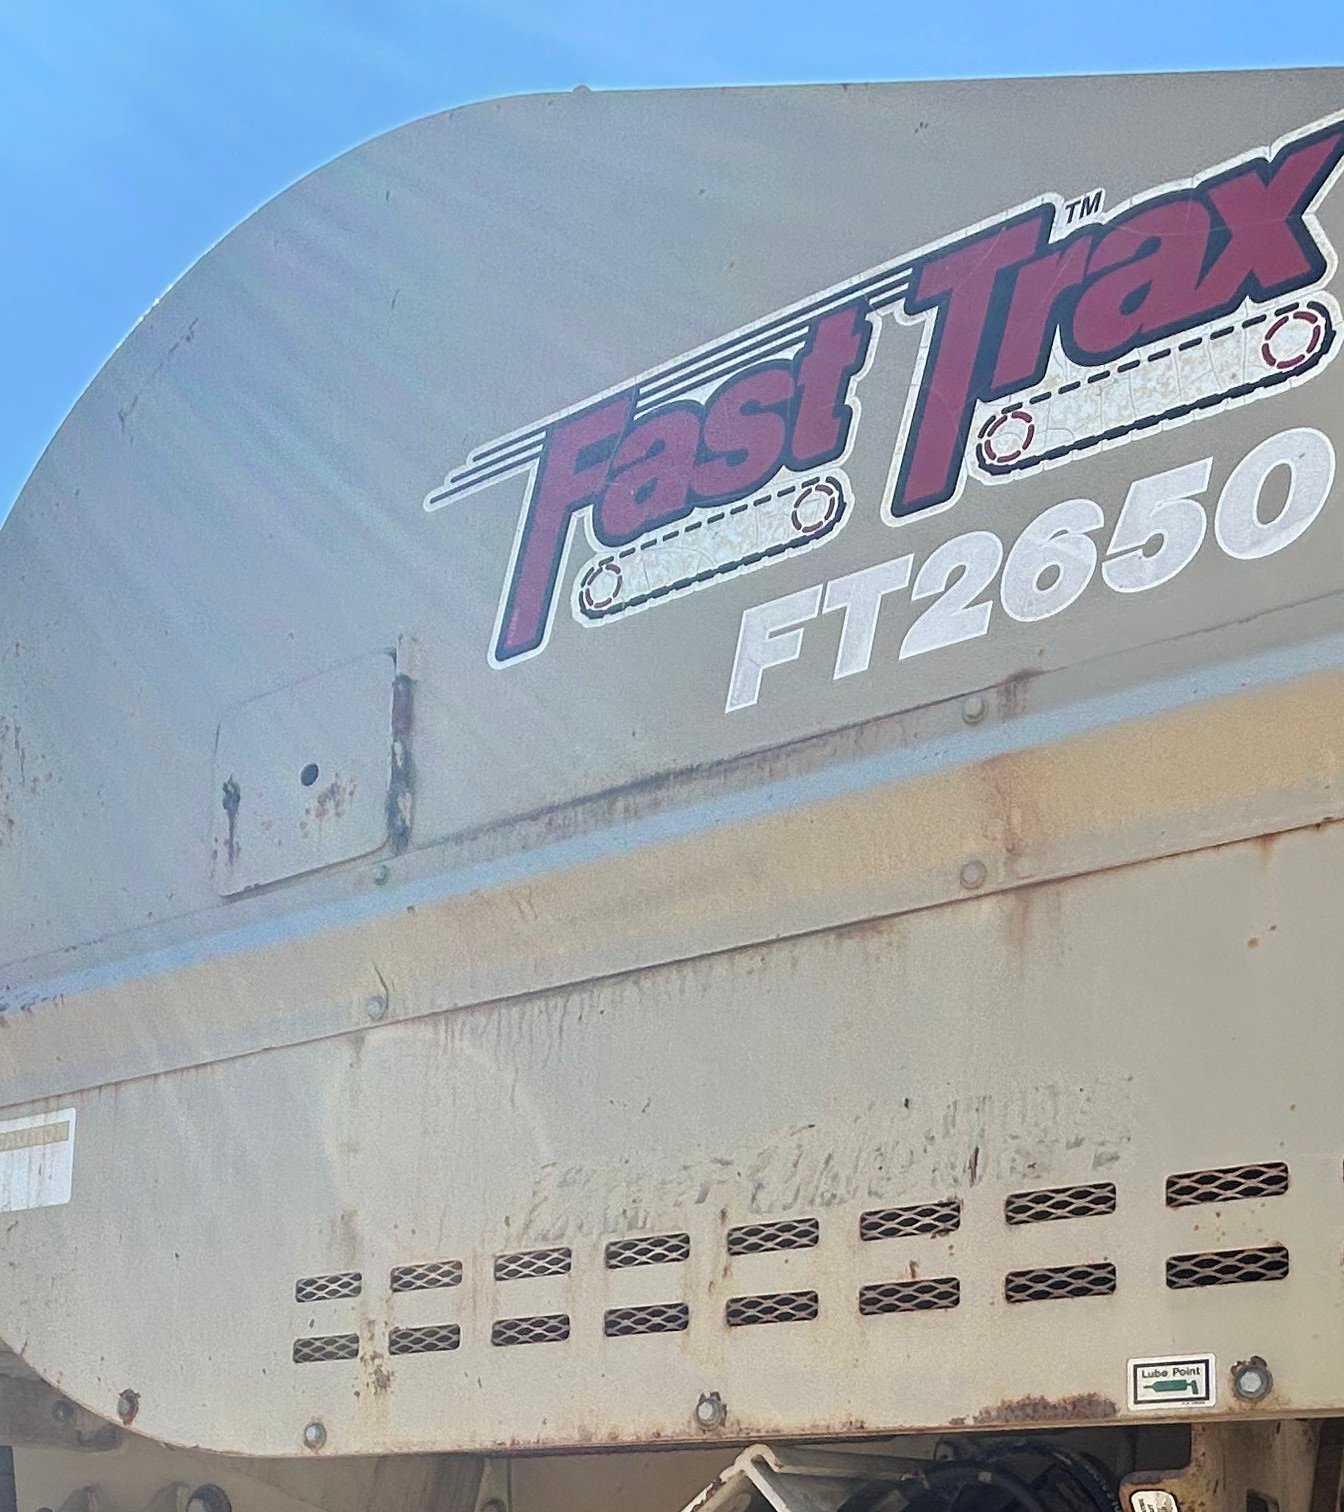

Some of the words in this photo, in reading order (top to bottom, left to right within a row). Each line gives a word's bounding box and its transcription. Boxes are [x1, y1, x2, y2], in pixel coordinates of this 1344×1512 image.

[1064, 191, 1103, 222] TM
[494, 294, 875, 665] Fast
[725, 426, 1336, 714] FT2650
[1141, 1368, 1168, 1379] Lube
[1172, 1366, 1201, 1377] Point
